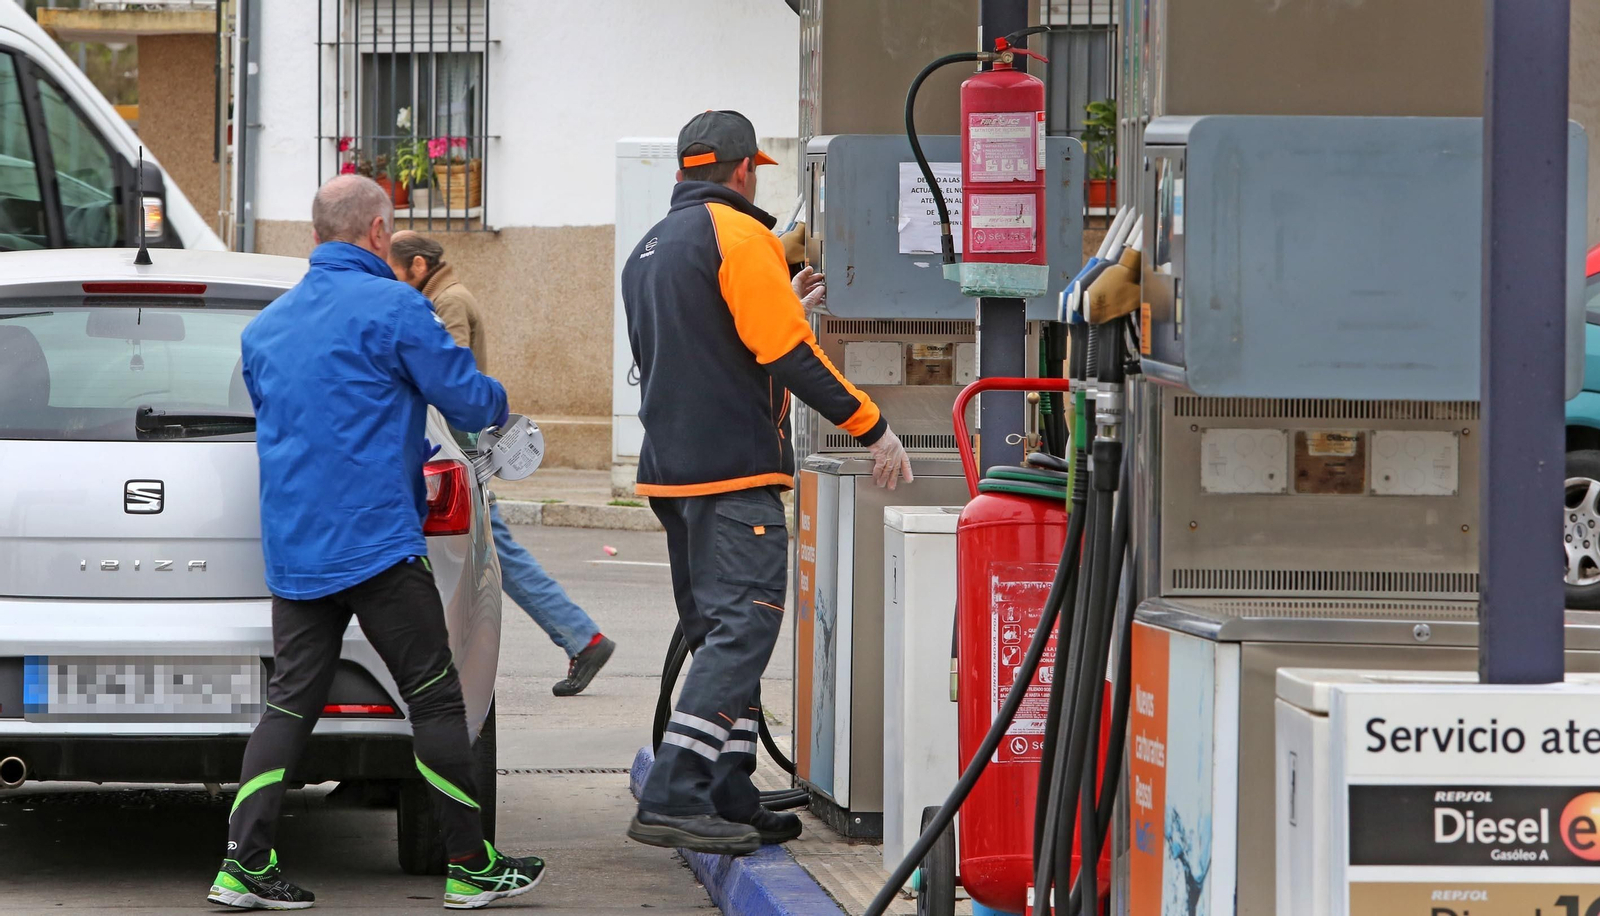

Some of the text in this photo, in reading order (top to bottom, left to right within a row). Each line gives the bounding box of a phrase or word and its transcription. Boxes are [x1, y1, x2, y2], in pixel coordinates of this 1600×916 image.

[80, 559, 207, 572] IBIZA
[1366, 717, 1526, 754] Servicio
[1135, 774, 1153, 816] Repsol
[1434, 791, 1493, 802] REPSOL
[1434, 807, 1549, 844] Diesel
[1490, 849, 1549, 861] Gasóleo A
[1431, 890, 1488, 901] REPSOL
